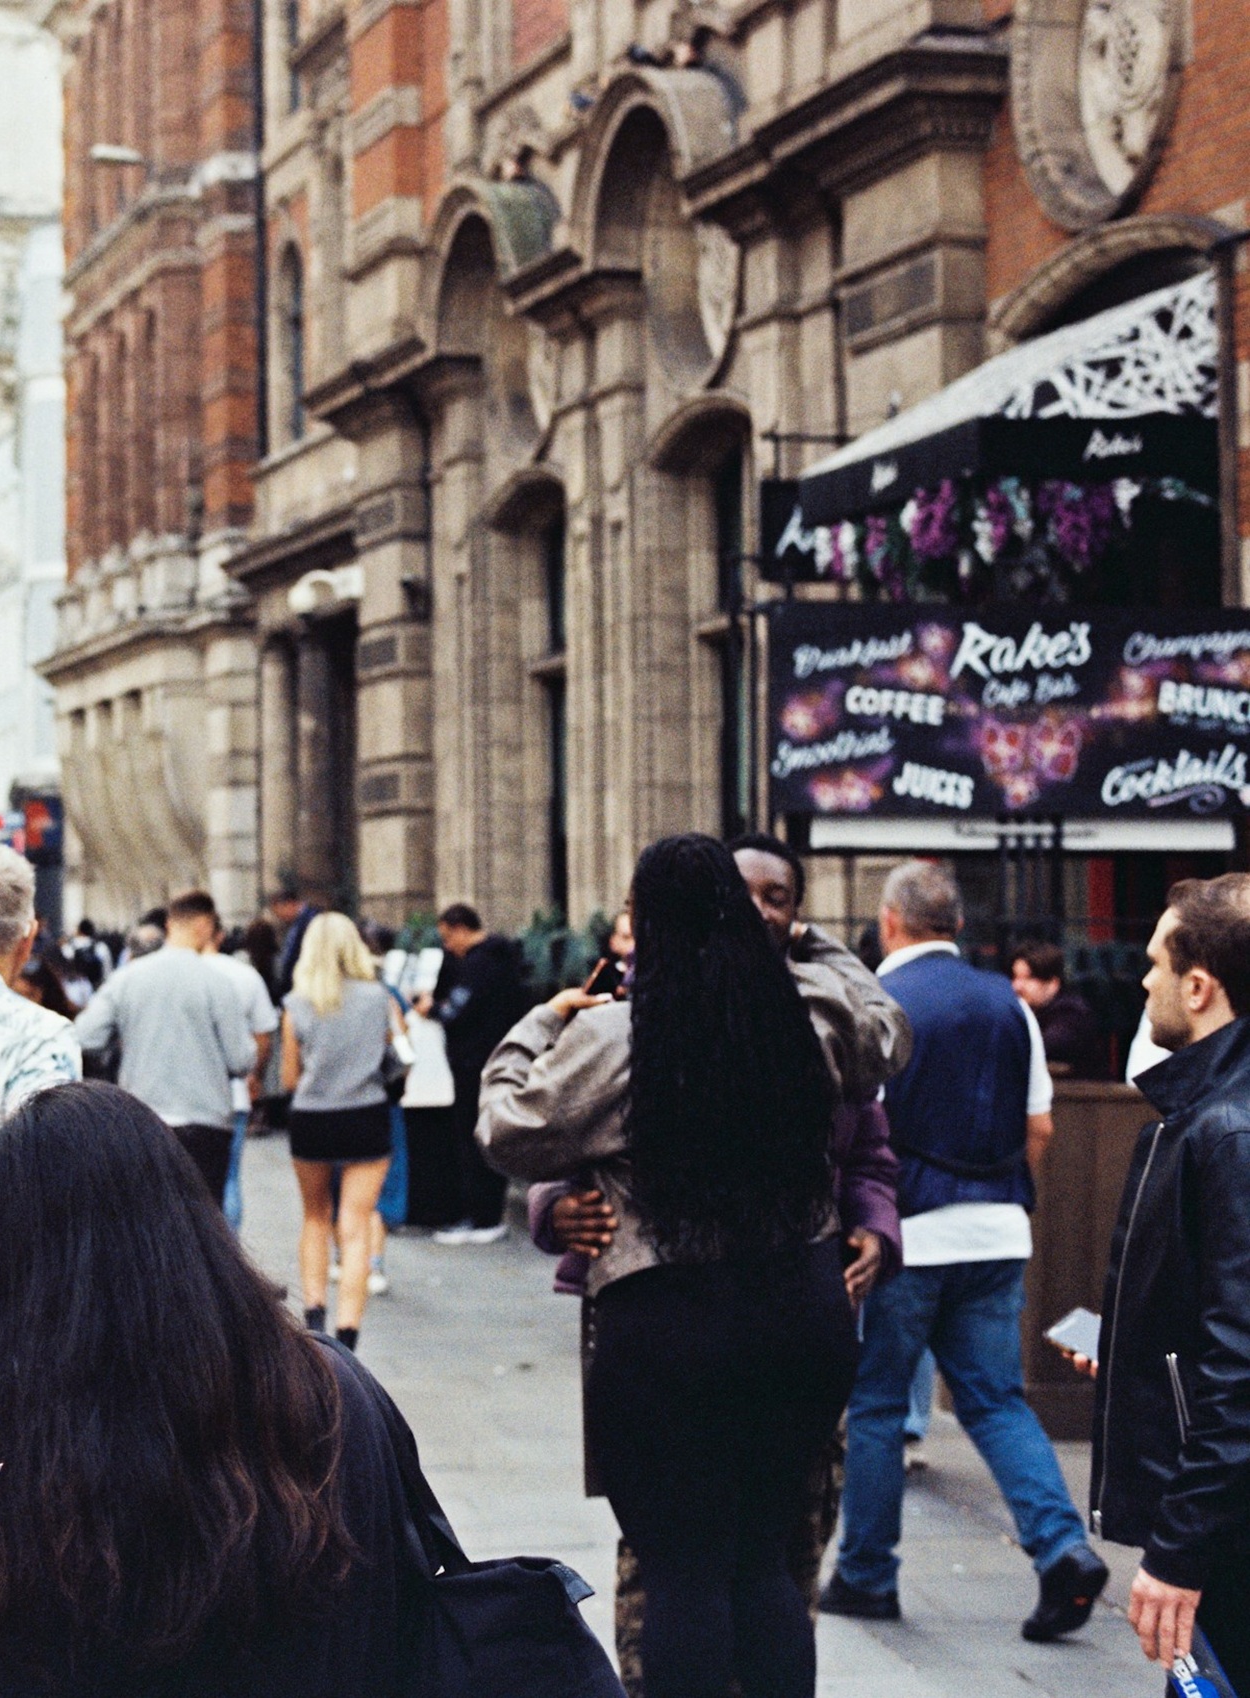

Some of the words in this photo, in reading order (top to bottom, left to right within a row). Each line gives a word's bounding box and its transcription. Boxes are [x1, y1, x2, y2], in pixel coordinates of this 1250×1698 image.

[949, 621, 1092, 681] Rake's
[845, 685, 946, 726] COFFEE
[892, 761, 975, 810] JUICES
[1101, 743, 1248, 807] Cocktails
